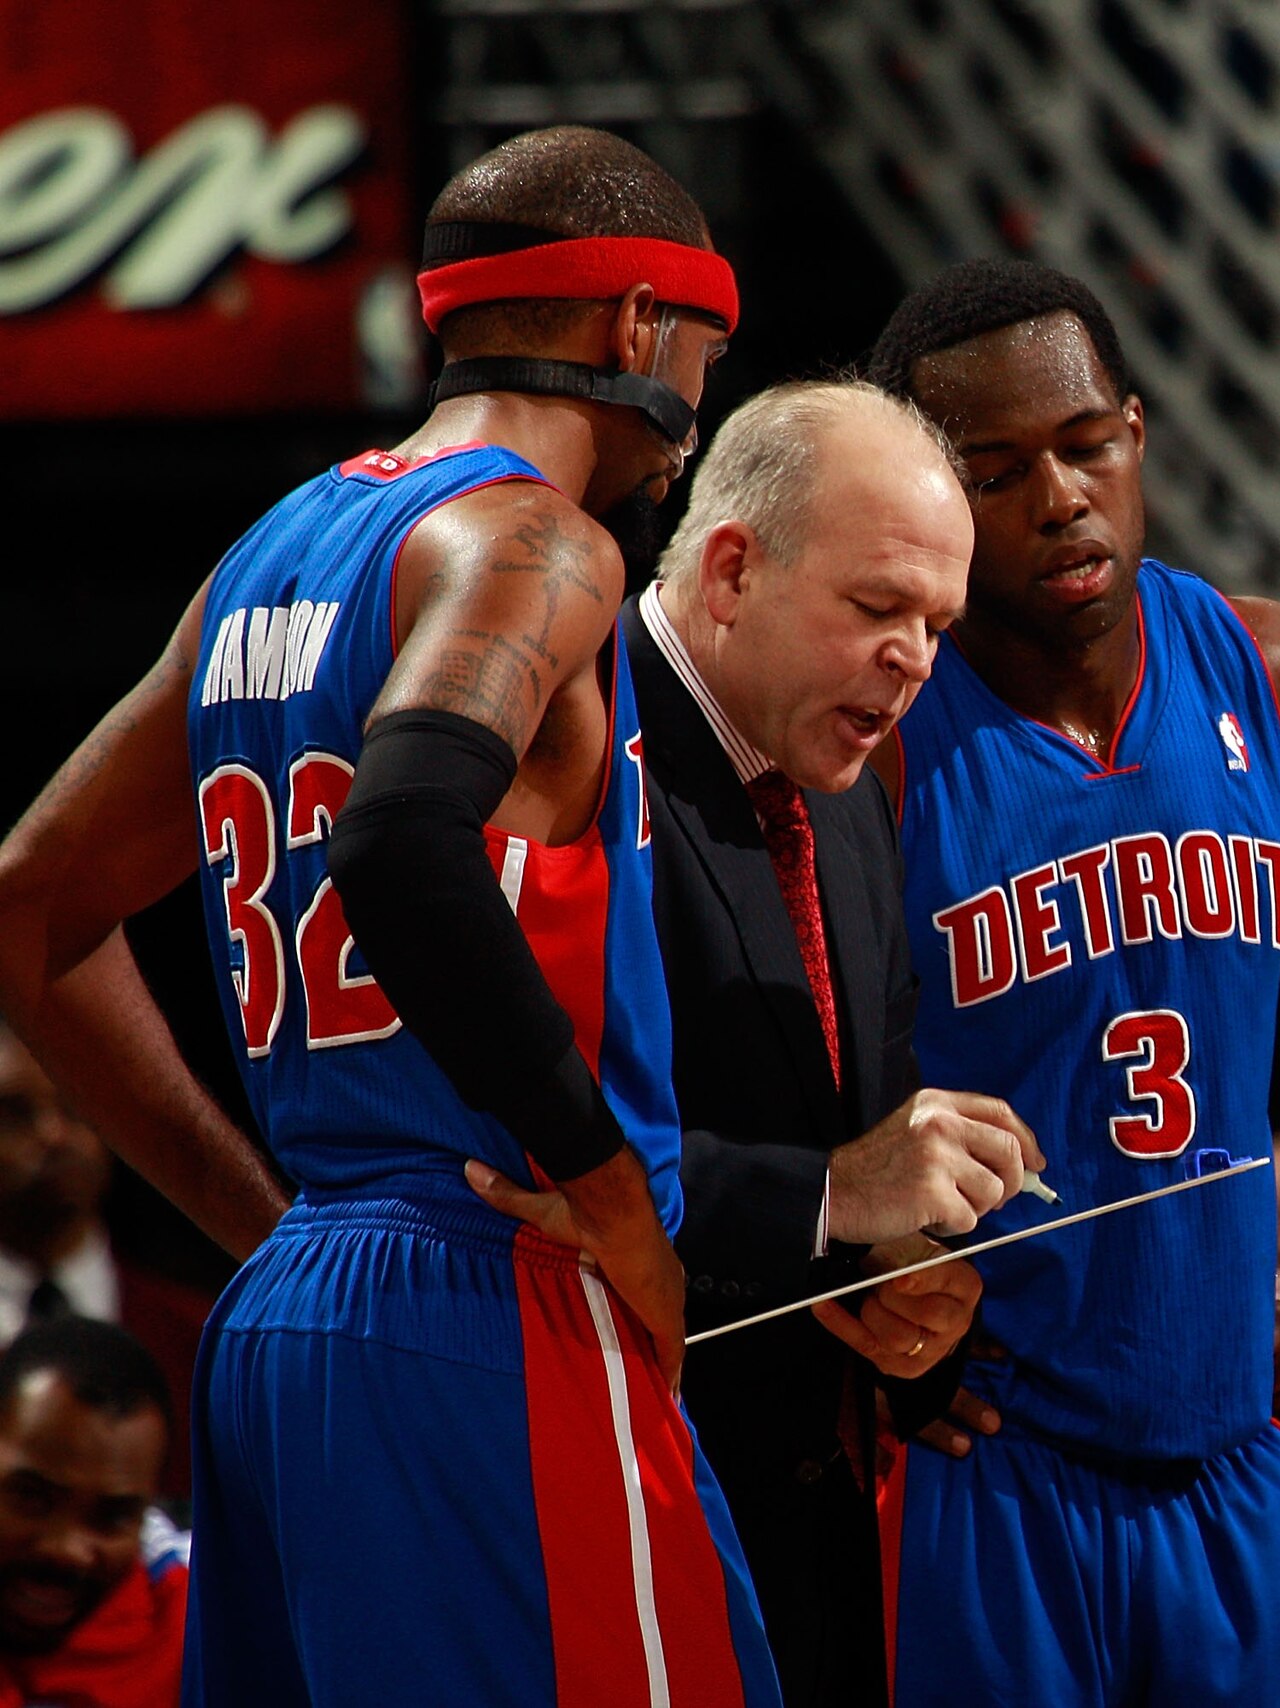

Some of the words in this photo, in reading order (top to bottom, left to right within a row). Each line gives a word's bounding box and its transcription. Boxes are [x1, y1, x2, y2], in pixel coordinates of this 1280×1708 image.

[201, 600, 340, 707] HAMON
[198, 751, 403, 1058] 32
[1102, 1008, 1195, 1160] 3
